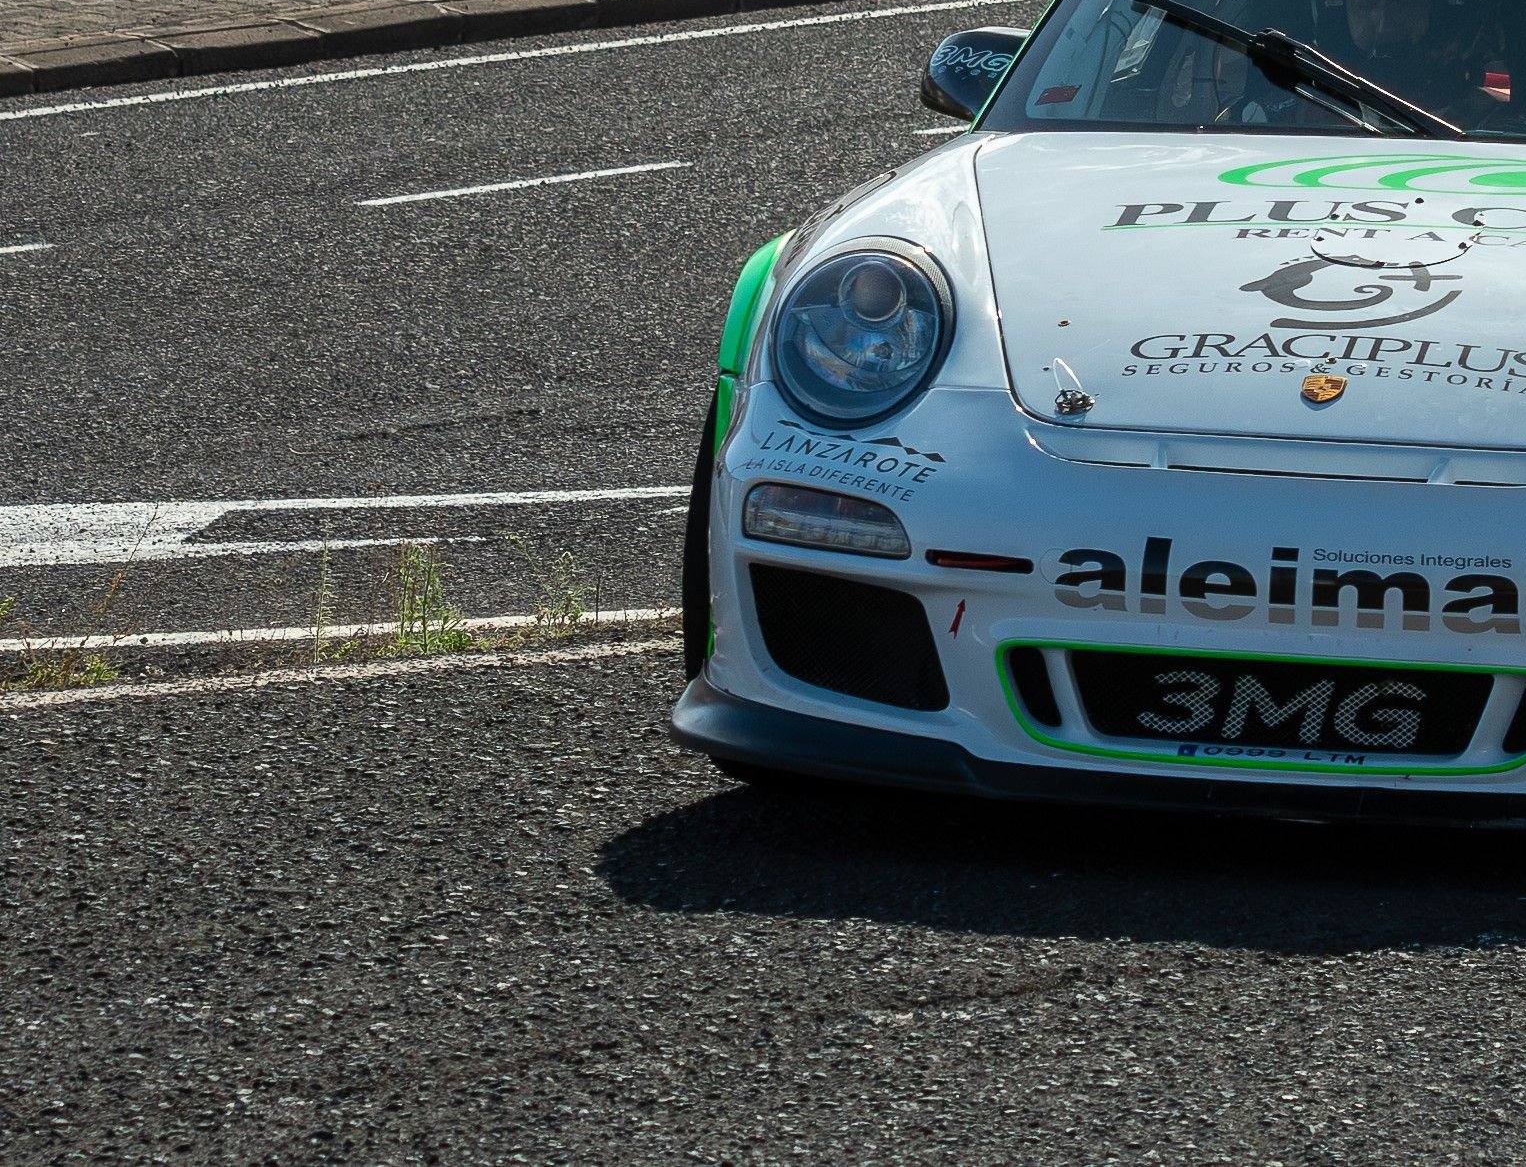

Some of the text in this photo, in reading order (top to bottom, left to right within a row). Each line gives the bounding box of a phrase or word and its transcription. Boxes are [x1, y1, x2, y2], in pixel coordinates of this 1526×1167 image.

[1110, 199, 1409, 231] PLUS
[1233, 228, 1391, 239] RENT
[1406, 231, 1446, 242] A
[1121, 362, 1296, 377] SEGUROS
[1310, 362, 1332, 375] &
[760, 432, 938, 484] LANZAROTE
[745, 458, 917, 503] LA ISLA DIFERENTE
[1313, 548, 1513, 570] Soluciones Integrales
[1053, 536, 1521, 635] aleima
[1136, 670, 1428, 750] 3MG
